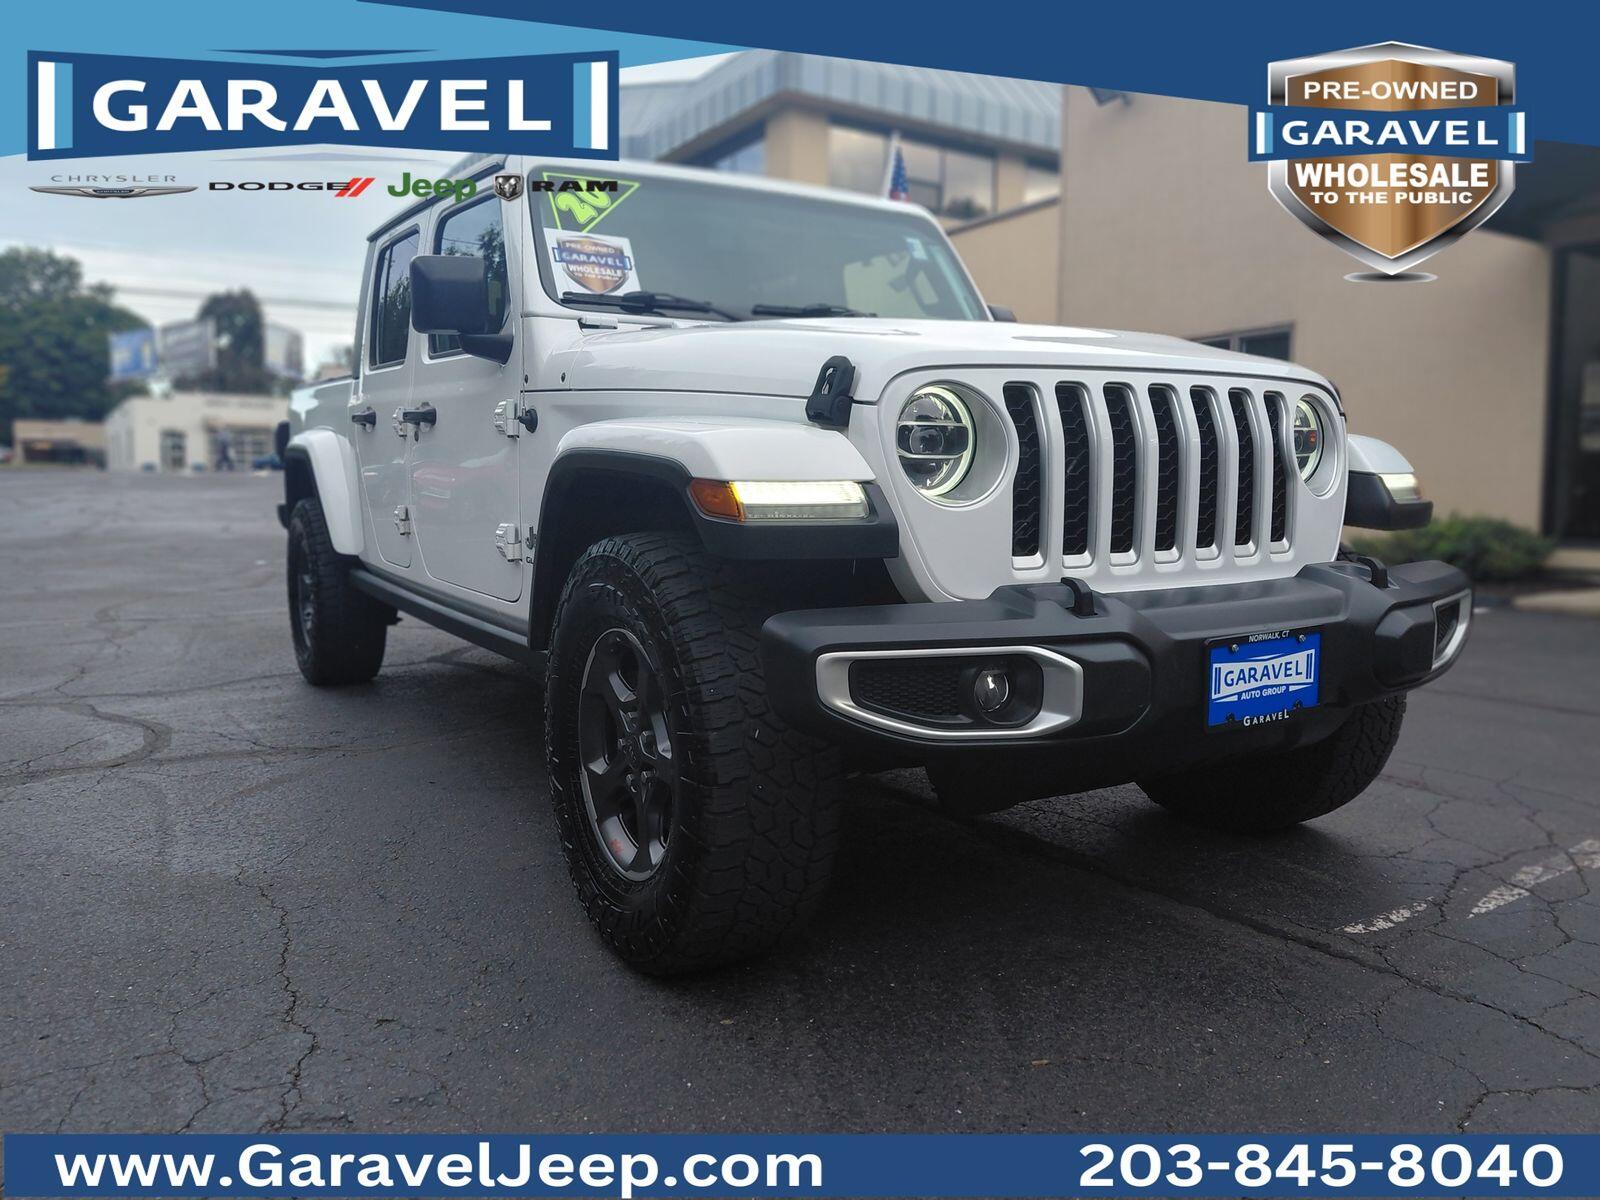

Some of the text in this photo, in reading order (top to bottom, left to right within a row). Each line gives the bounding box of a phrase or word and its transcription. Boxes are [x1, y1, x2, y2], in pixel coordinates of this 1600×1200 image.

[1281, 630, 1290, 638] CT
[1224, 660, 1303, 687] GARAVEL
[1240, 685, 1287, 701] AUTO GROUP
